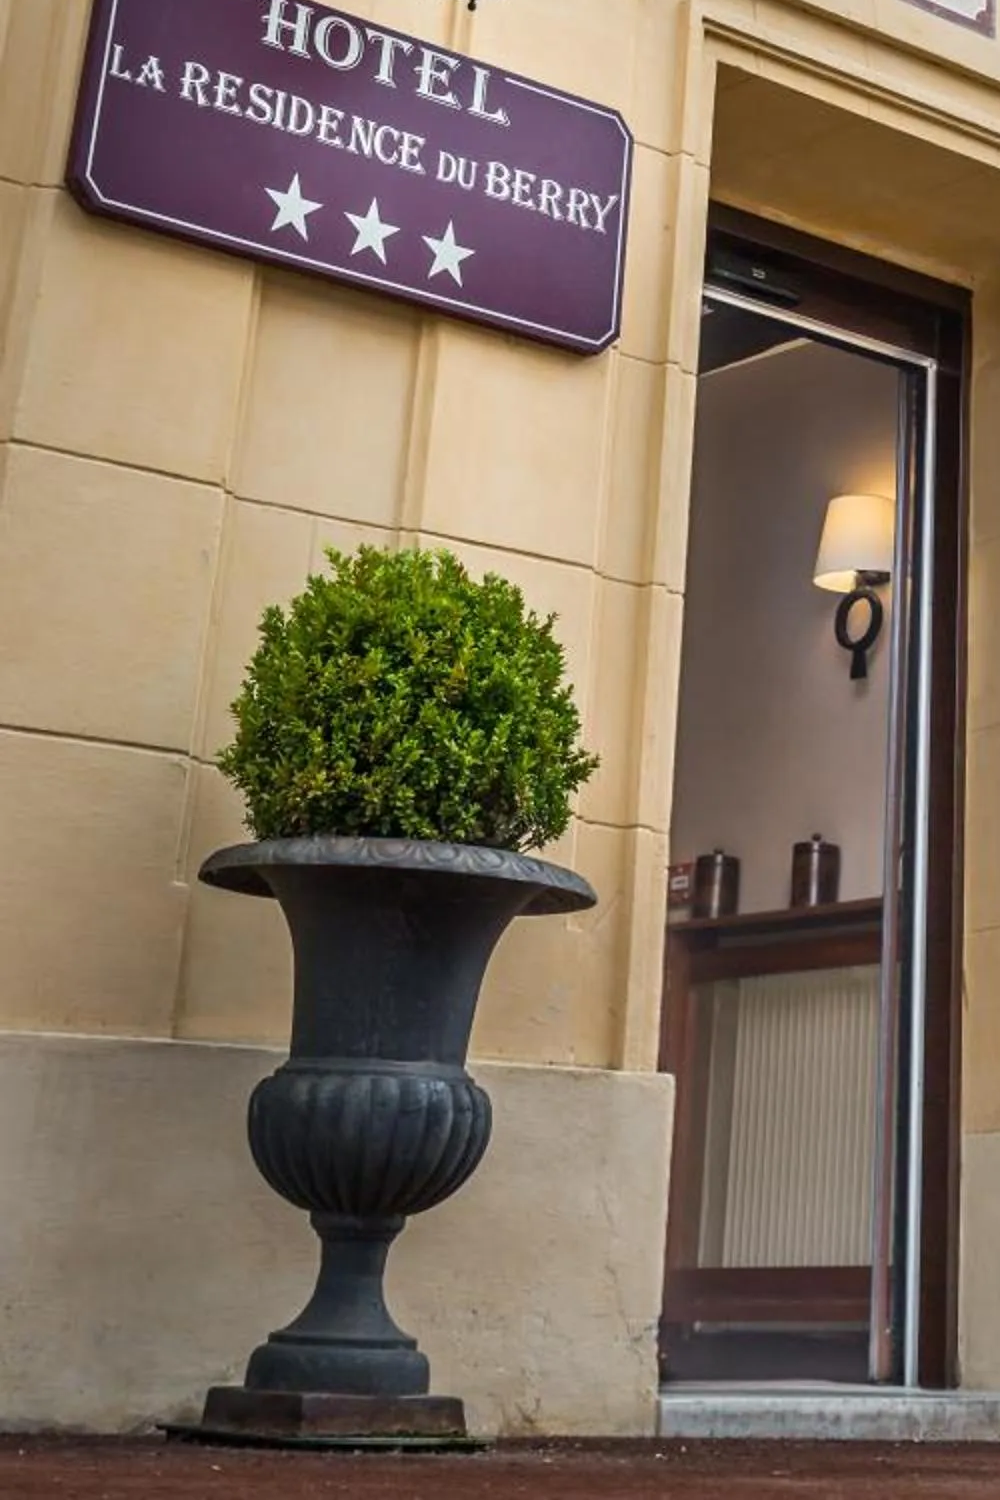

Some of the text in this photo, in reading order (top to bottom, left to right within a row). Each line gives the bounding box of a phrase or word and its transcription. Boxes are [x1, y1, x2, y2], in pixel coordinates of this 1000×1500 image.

[109, 43, 618, 234] LA RESIDENCE DU BERRY
